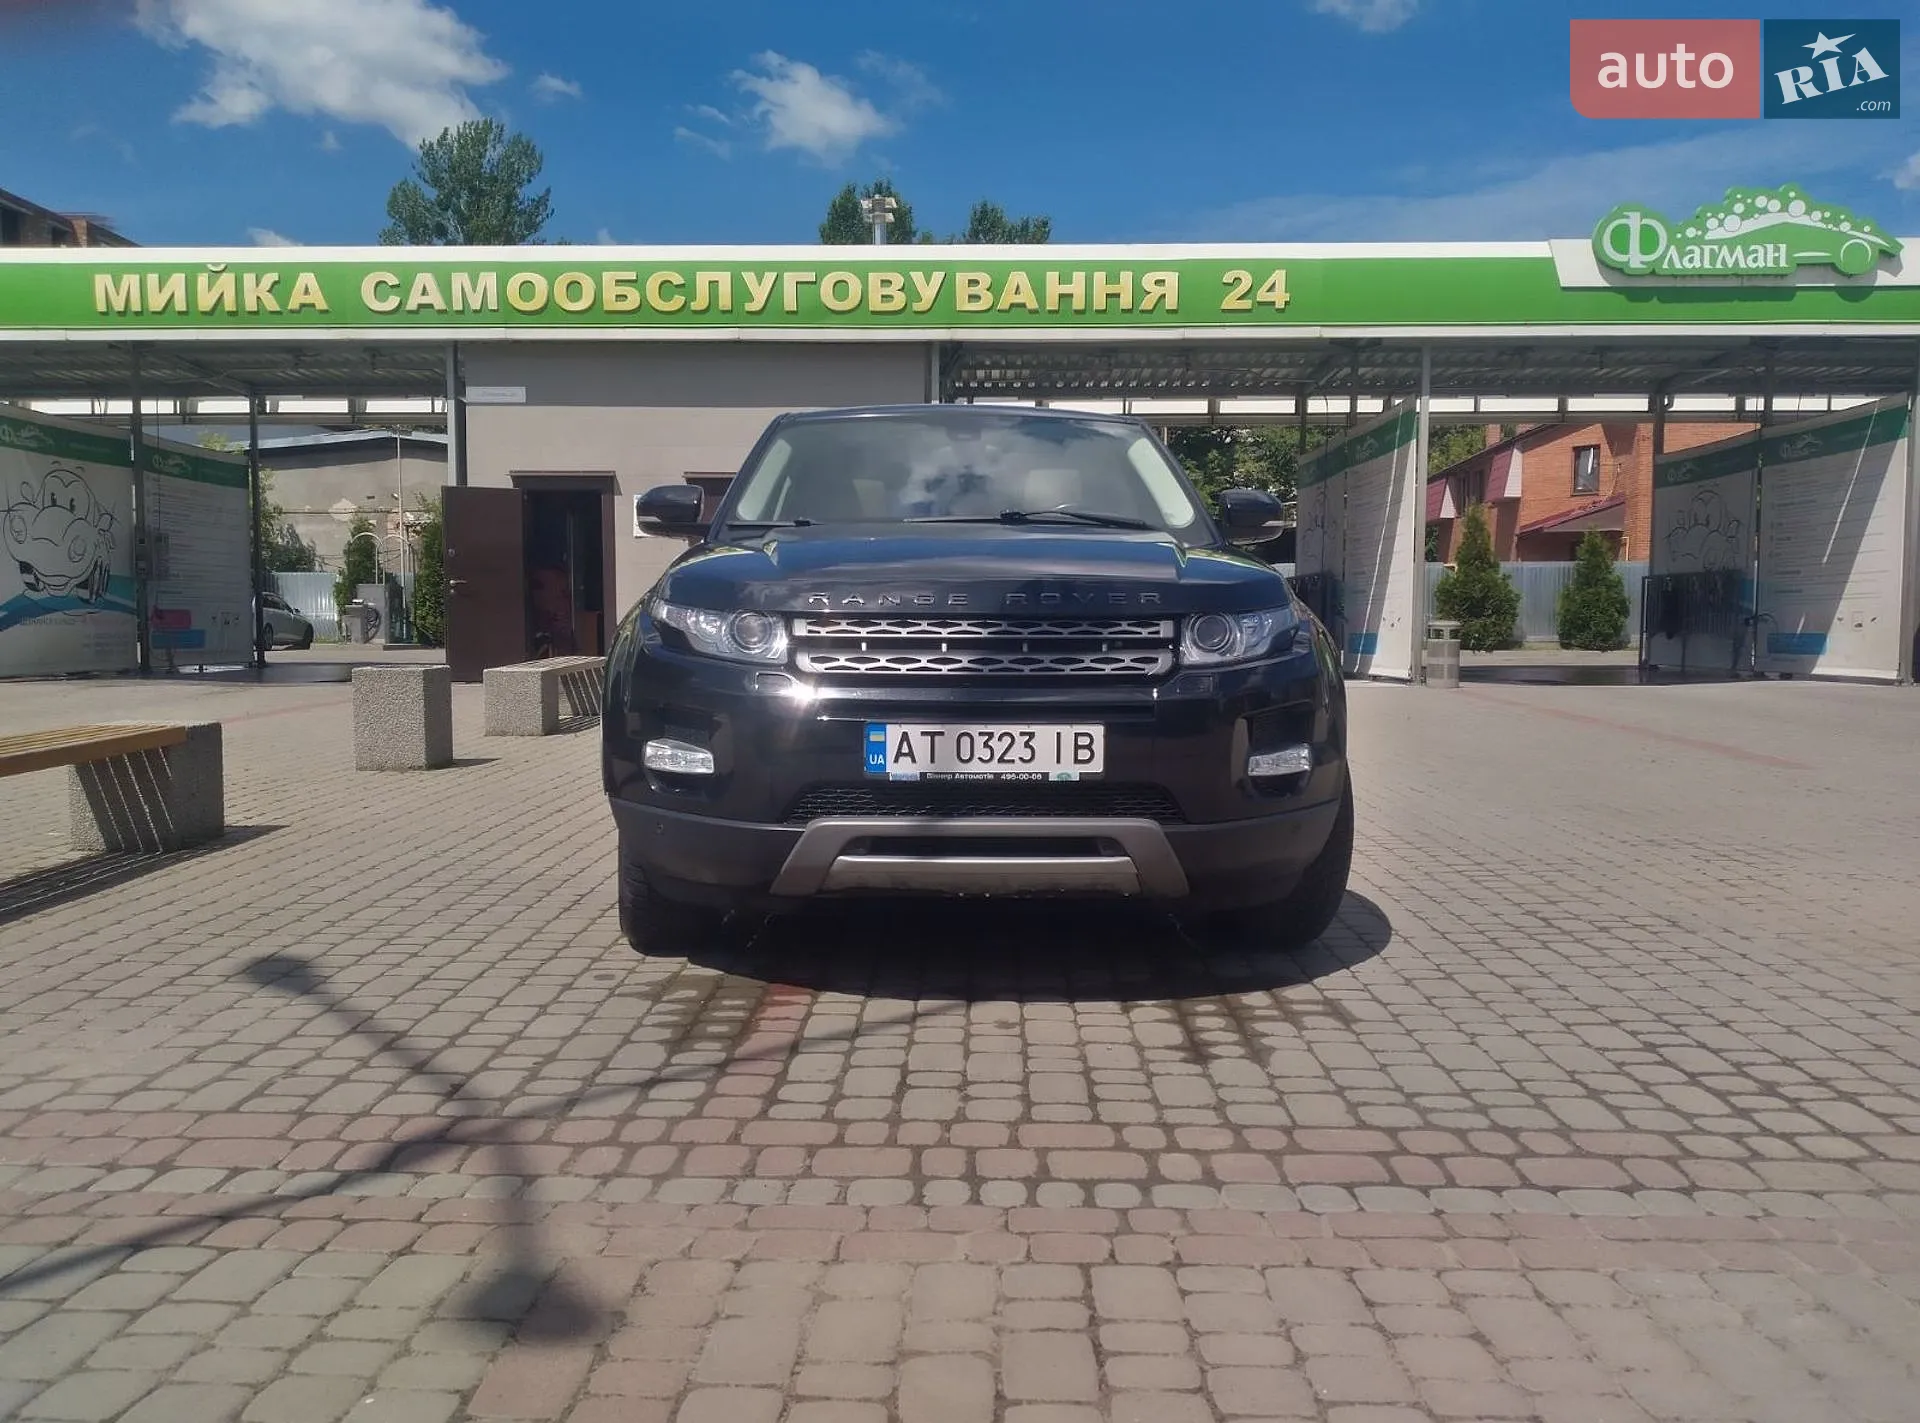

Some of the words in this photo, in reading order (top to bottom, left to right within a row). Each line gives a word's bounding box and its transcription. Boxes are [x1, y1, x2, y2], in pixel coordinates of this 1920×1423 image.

[1602, 211, 1789, 269] Флагман
[94, 263, 329, 313] МИЙКА
[361, 269, 1180, 313] САМООБСЛУГОВУВАННЯ
[1220, 269, 1290, 311] 24
[808, 592, 969, 607] RANGE
[1005, 591, 1161, 606] ROVER
[869, 753, 885, 766] UA
[956, 731, 1036, 765] 0323
